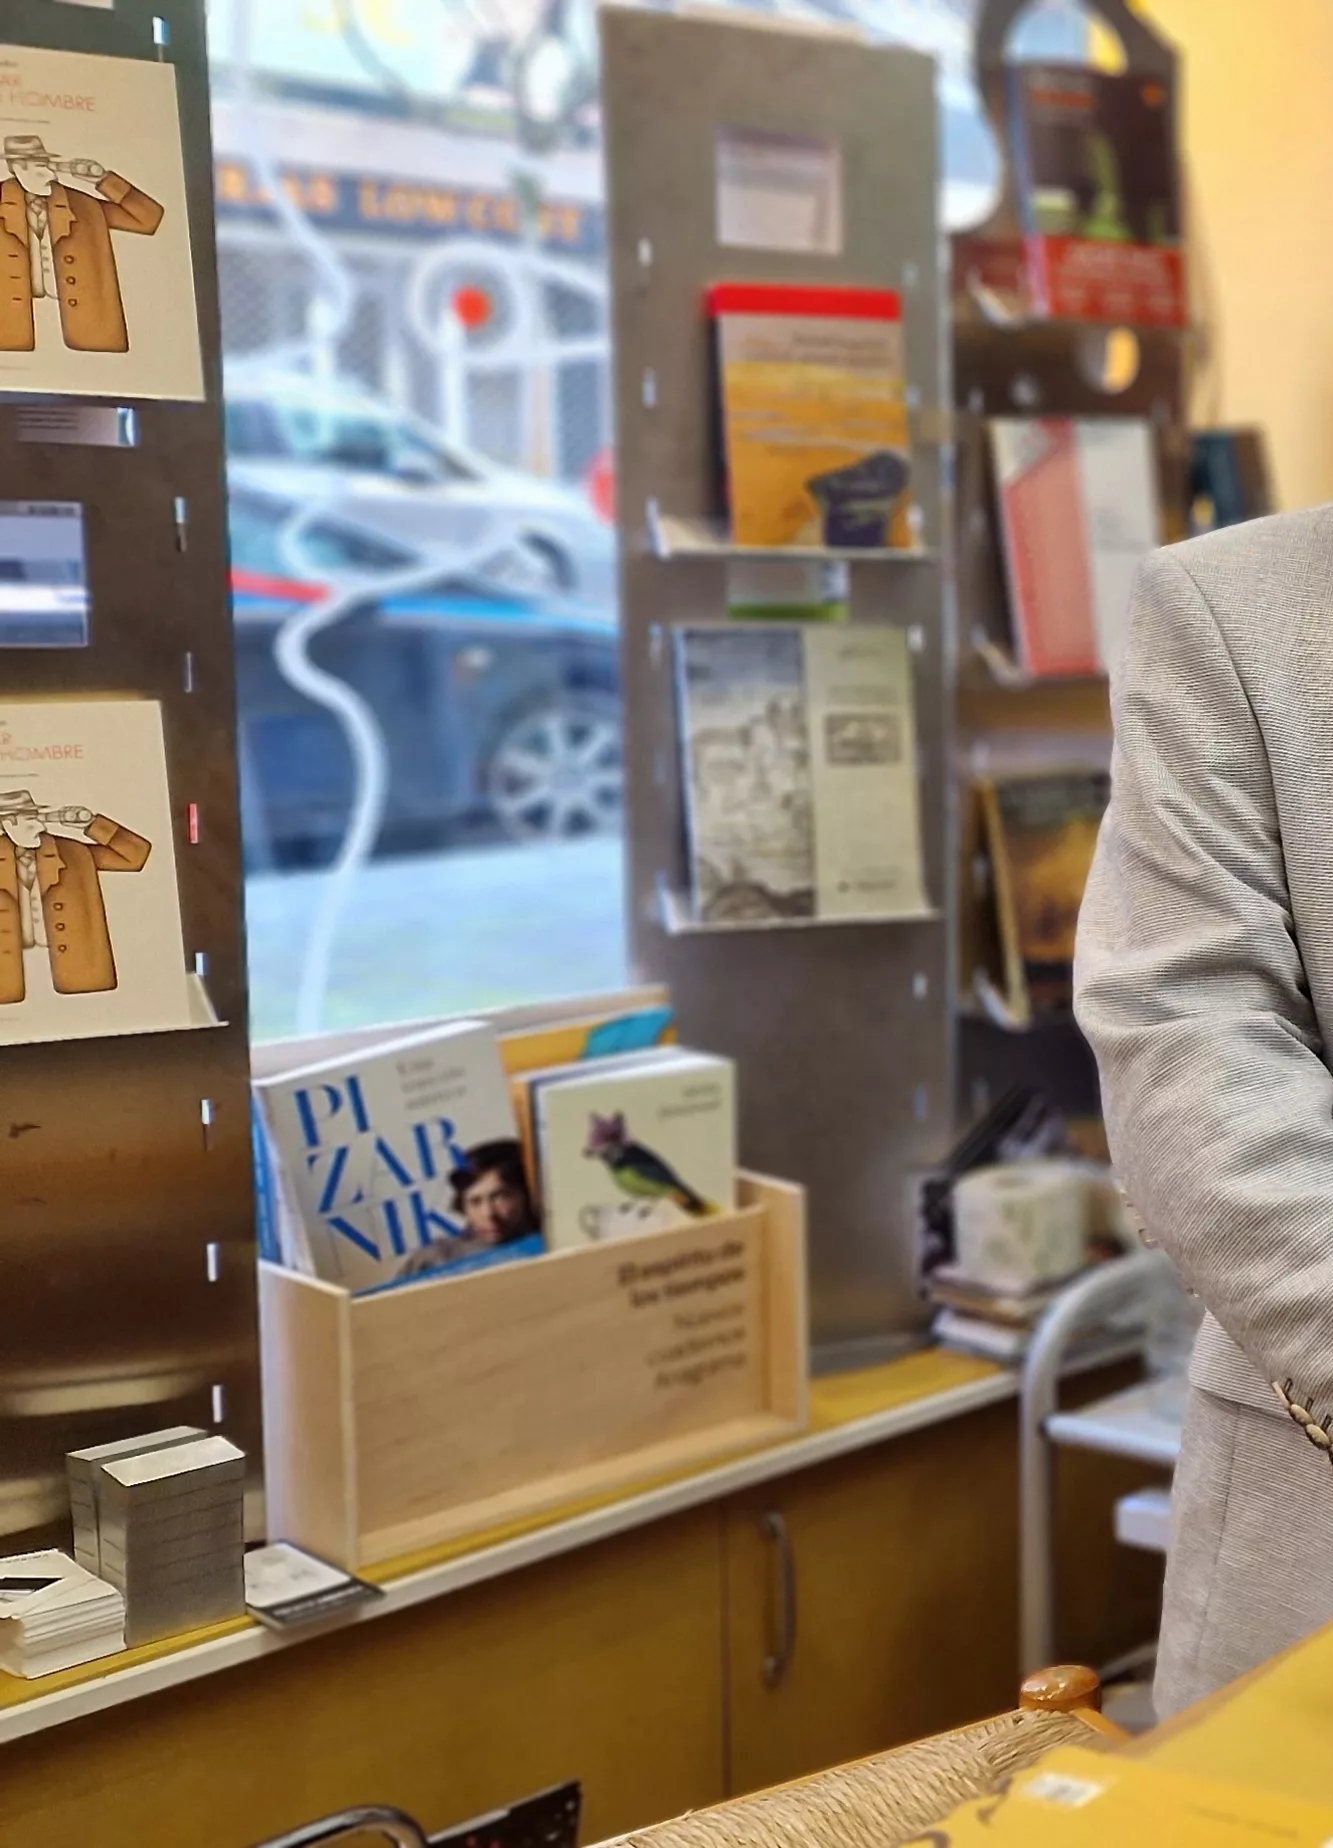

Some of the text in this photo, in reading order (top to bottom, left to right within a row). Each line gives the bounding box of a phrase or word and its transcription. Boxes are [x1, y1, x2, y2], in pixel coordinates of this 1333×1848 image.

[10, 90, 96, 112] HOMBRE
[294, 1074, 370, 1150] PI
[305, 1115, 469, 1216] ZAR
